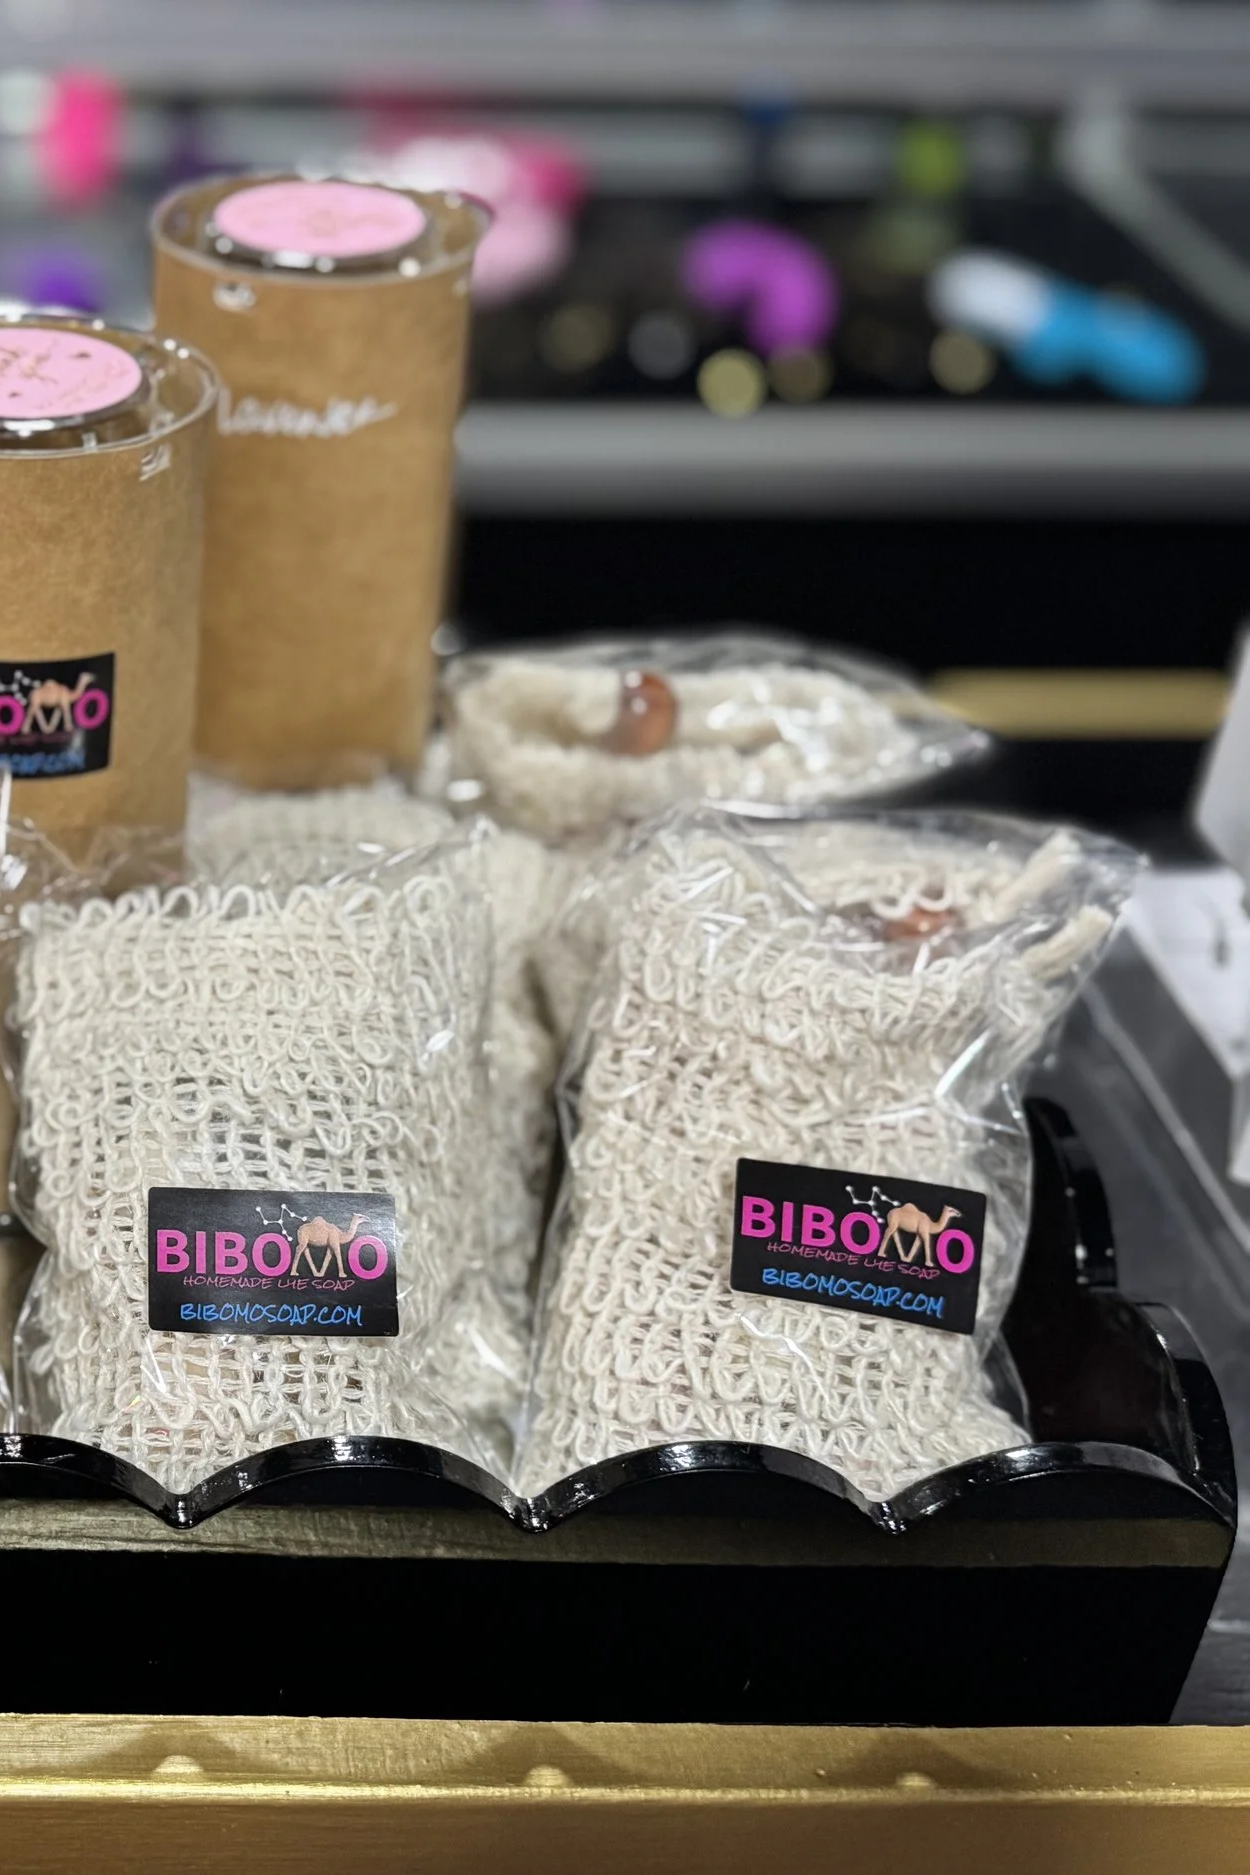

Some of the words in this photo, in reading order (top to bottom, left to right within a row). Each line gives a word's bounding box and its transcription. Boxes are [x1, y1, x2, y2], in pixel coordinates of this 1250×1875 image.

[156, 1229, 389, 1280] BIBOMO
[740, 1195, 975, 1274] BIBOMO
[182, 1275, 275, 1290] HOMEMADE
[277, 1278, 310, 1291] LYE
[312, 1278, 356, 1292] SOAP
[766, 1242, 861, 1266] HOMEMADE
[863, 1257, 896, 1273] LYE
[897, 1263, 942, 1281] SOAP
[179, 1302, 364, 1328] BIBOMOSOAP.COM
[762, 1267, 946, 1320] BIBOMOSOAP.COM
